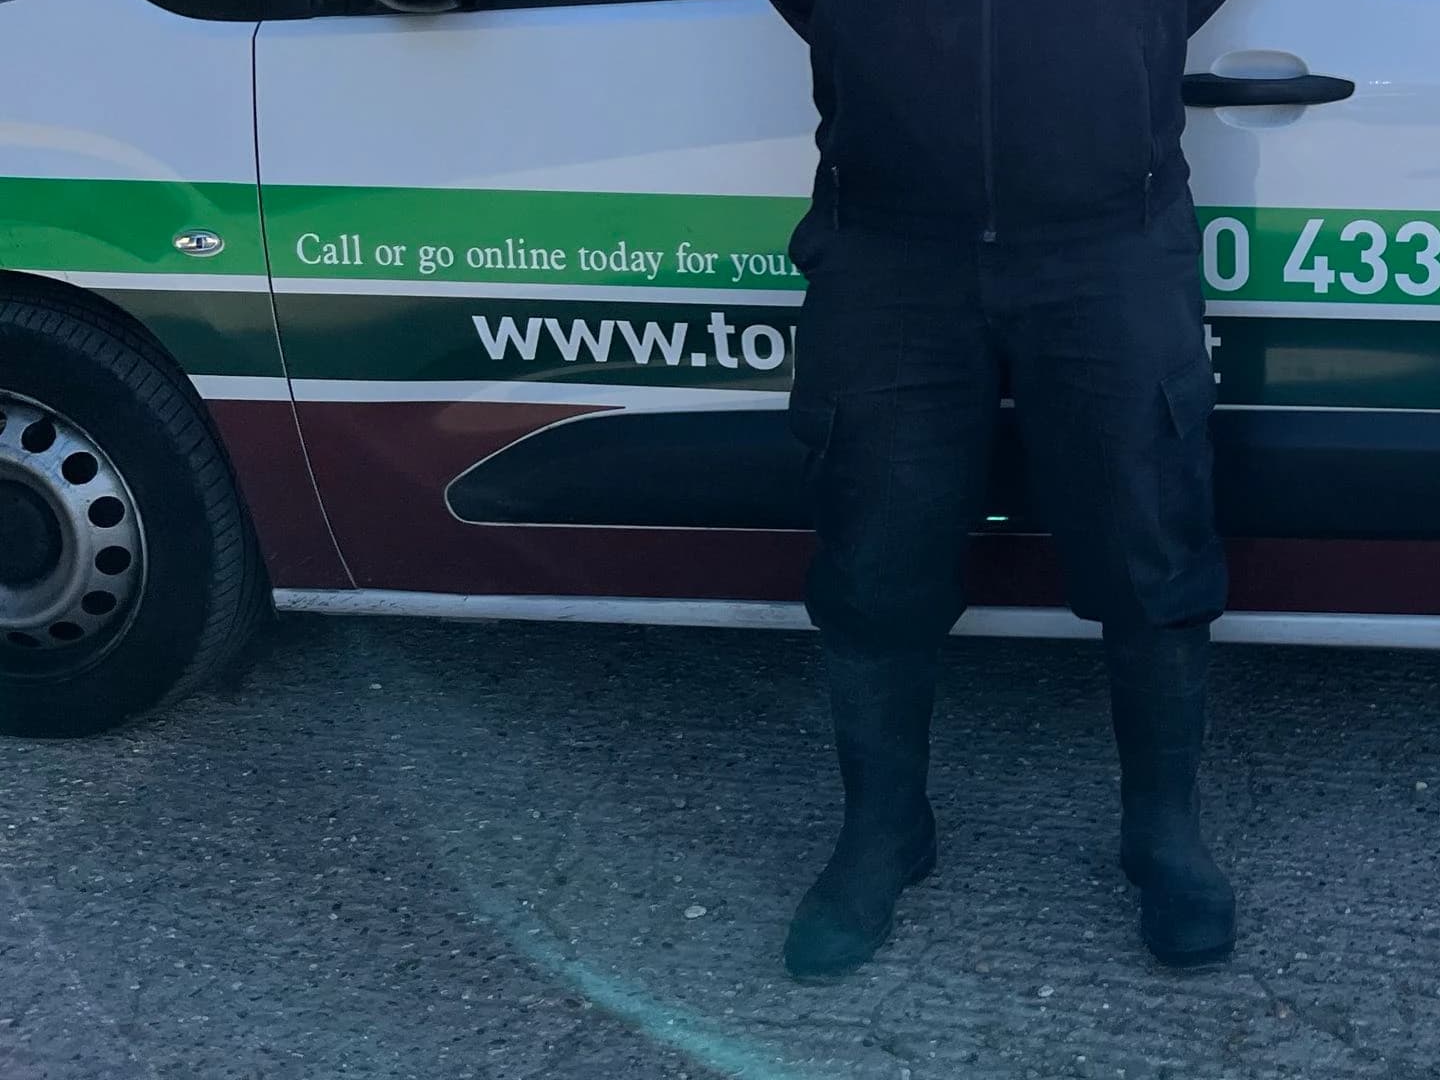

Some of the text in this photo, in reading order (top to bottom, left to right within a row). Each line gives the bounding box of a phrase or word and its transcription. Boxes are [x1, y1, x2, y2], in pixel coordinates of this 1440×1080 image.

[296, 233, 363, 266] Call
[375, 245, 406, 266] or
[419, 247, 454, 274] go
[466, 238, 566, 271] online
[578, 241, 664, 280] today
[676, 242, 718, 274] for
